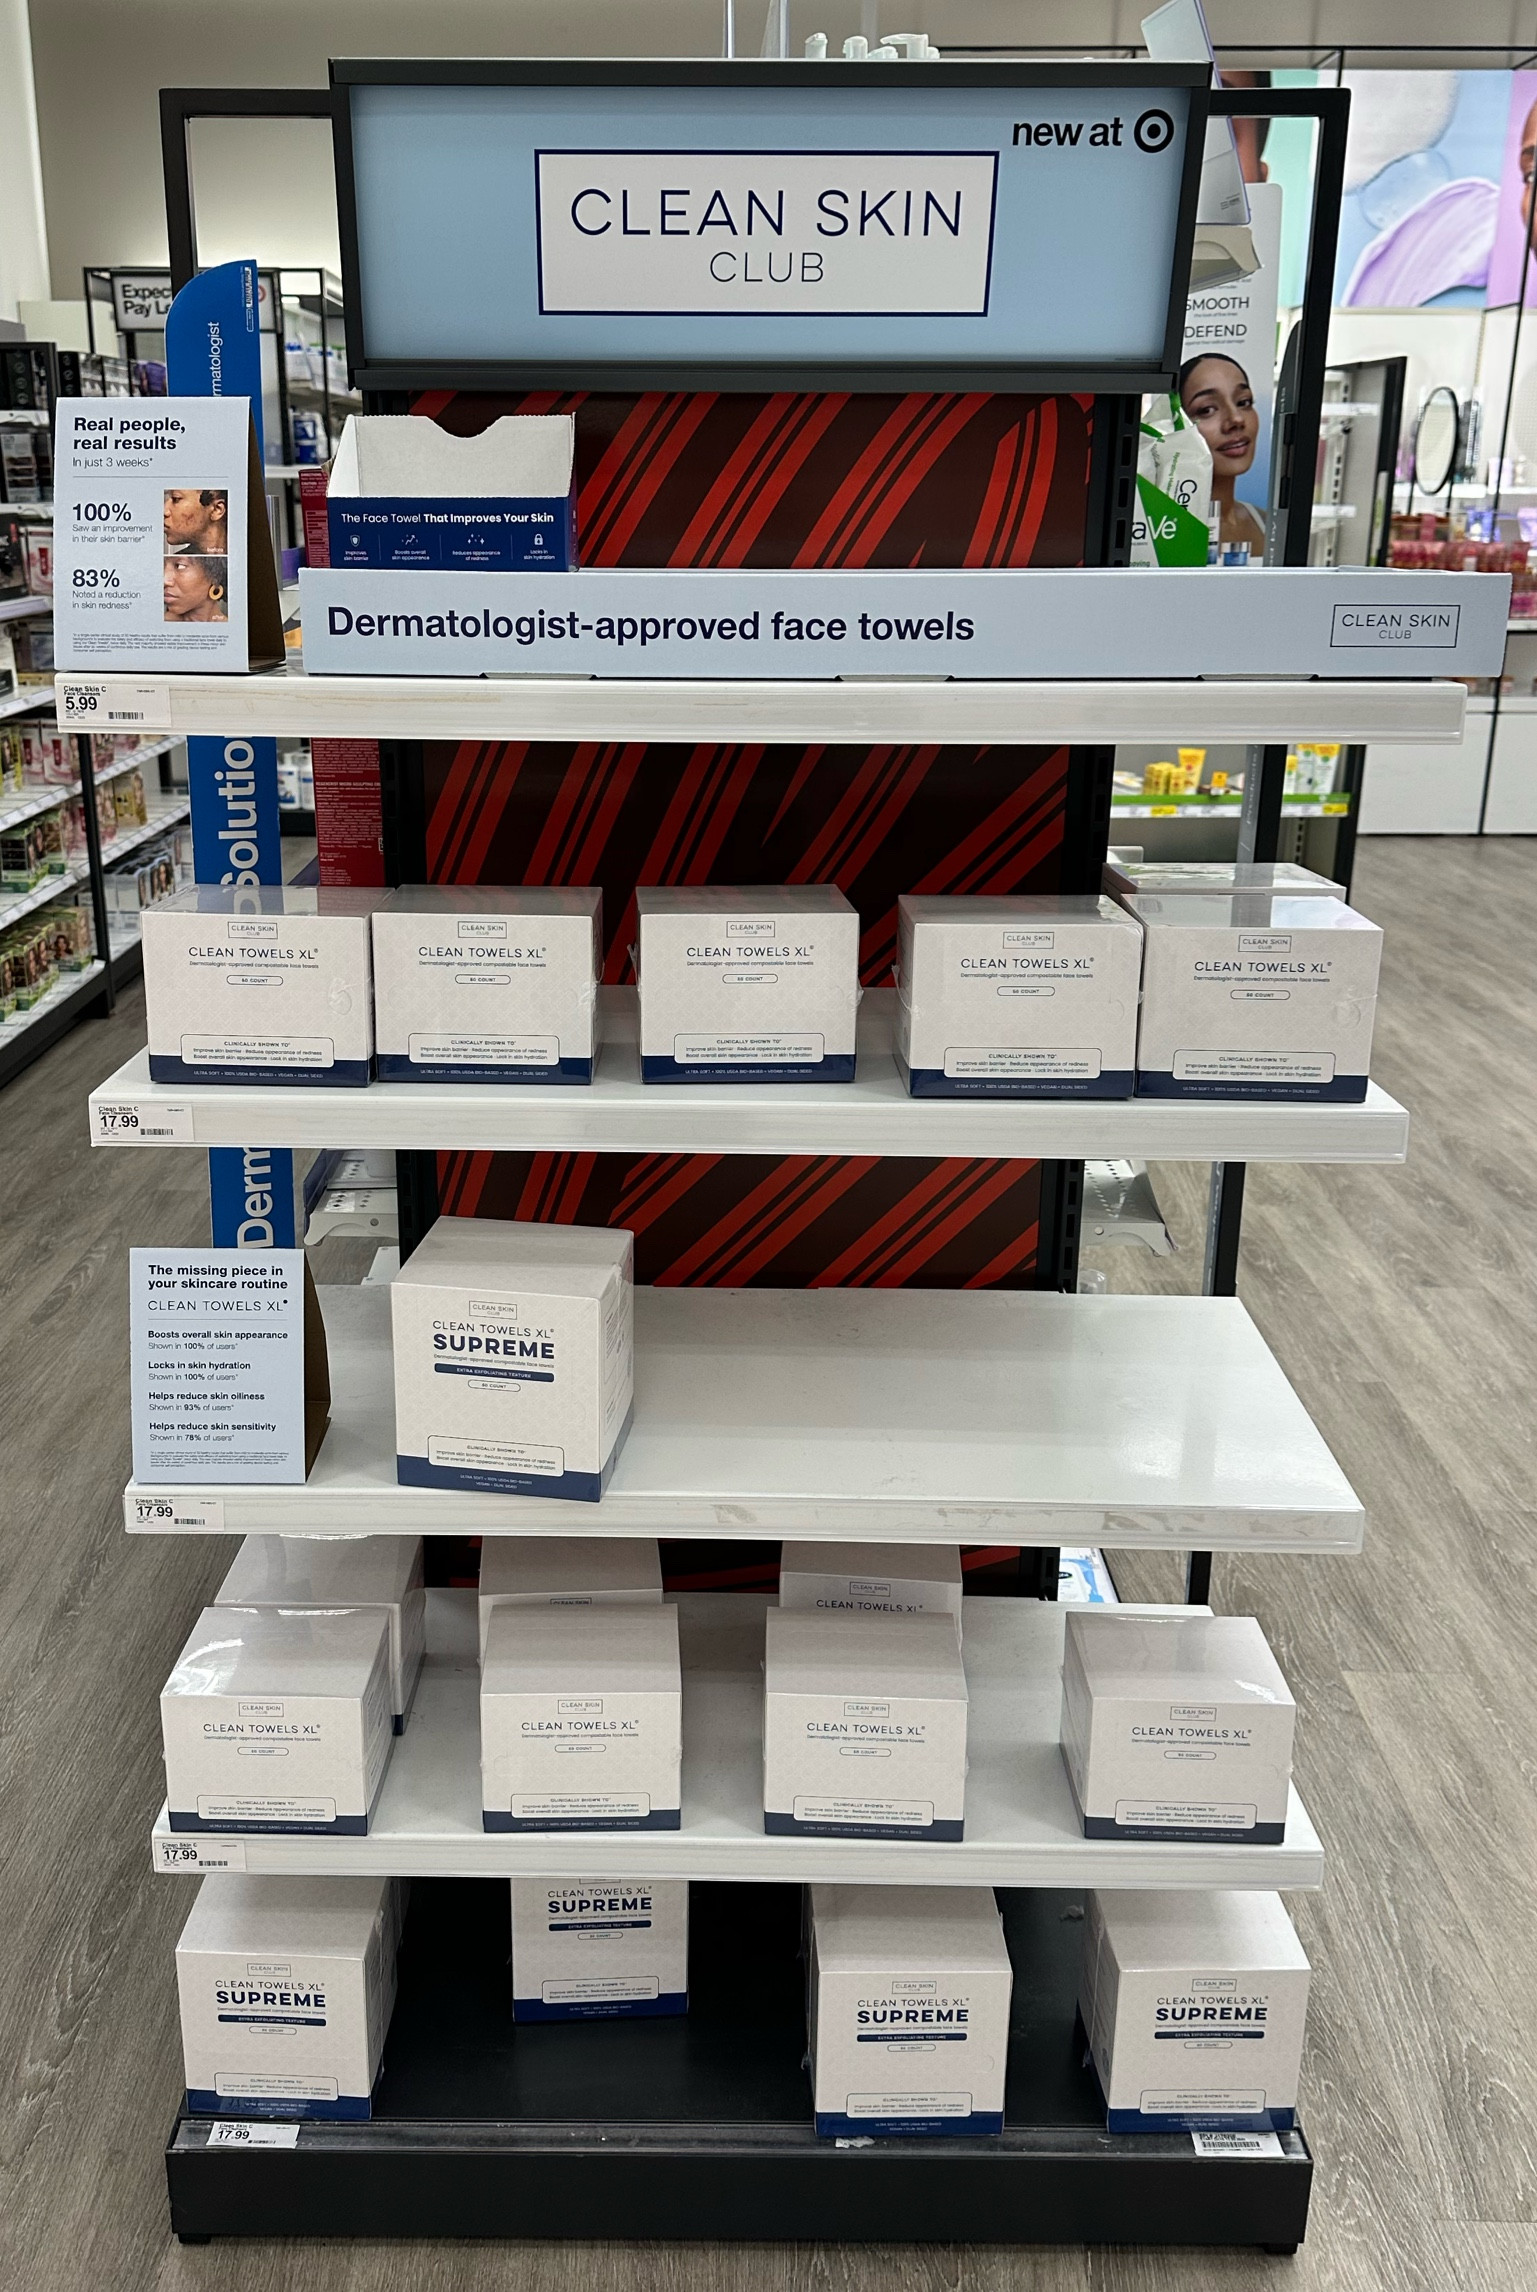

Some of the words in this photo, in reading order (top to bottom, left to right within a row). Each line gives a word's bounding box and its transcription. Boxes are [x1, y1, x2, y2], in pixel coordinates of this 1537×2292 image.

[1011, 123, 1084, 146] new
[1089, 117, 1123, 146] at
[571, 188, 783, 236] CLEAN
[816, 189, 961, 237] SKIN
[710, 251, 823, 282] CLUB
[122, 284, 172, 301] Expec
[123, 300, 151, 318] Pay
[1186, 297, 1249, 311] SMOOTH
[1184, 324, 1247, 339] DEFEND
[207, 322, 224, 397] rmatologist
[74, 417, 113, 431] Real
[120, 417, 185, 434] people,
[73, 435, 107, 450] real
[114, 435, 176, 450] results
[72, 457, 81, 467] In
[84, 457, 103, 469] just
[106, 457, 113, 467] 3
[72, 503, 131, 522] 100%
[341, 513, 360, 523] The
[363, 513, 388, 523] Face
[390, 513, 421, 523] Towel
[423, 513, 448, 523] That
[450, 513, 501, 525] Improves
[503, 513, 529, 523] Your
[530, 512, 554, 522] Skin
[72, 523, 90, 532] Saw
[103, 525, 153, 533] improvement
[81, 535, 98, 543] their
[100, 535, 115, 543] skin
[72, 569, 120, 588] 83%
[72, 590, 96, 598] Noted
[104, 591, 141, 599] reduction
[81, 601, 97, 609] skin
[328, 606, 759, 646] Dermatologist-approved
[770, 611, 847, 640] face
[858, 611, 974, 640] towels
[1342, 613, 1402, 628] CLEAN
[1408, 613, 1451, 628] SKIN
[1378, 629, 1411, 639] CLUB
[65, 696, 97, 710] 5.99
[214, 736, 260, 885] olutio
[188, 946, 234, 957] CLEAN
[239, 948, 294, 959] TOWELS
[418, 946, 463, 957] CLEAN
[468, 947, 522, 958] TOWELS
[686, 947, 731, 957] CLEAN
[736, 946, 790, 957] TOWELS
[960, 958, 1007, 968] CLEAN
[1012, 958, 1068, 968] TOWELS
[1194, 961, 1242, 972] CLEAN
[1247, 962, 1305, 973] TOWELS
[100, 1115, 139, 1128] 17.99
[148, 1264, 173, 1275] The
[177, 1265, 227, 1277] missing
[232, 1265, 267, 1277] piece
[271, 1265, 283, 1276] in
[148, 1280, 177, 1290] your
[181, 1278, 237, 1289] skincare
[241, 1278, 288, 1289] routine
[147, 1300, 196, 1310] CLEAN
[202, 1300, 261, 1311] TOWELS
[472, 1304, 496, 1312] CLEAN
[148, 1330, 180, 1338] Boosts
[181, 1330, 211, 1338] overall
[214, 1330, 232, 1338] skin
[234, 1332, 288, 1340] appearance
[432, 1320, 474, 1334] CLEAN
[479, 1324, 531, 1337] TOWELS
[184, 1342, 205, 1350] 100%
[433, 1333, 554, 1359] SUPREME
[148, 1361, 175, 1369] Locks
[177, 1361, 185, 1369] in
[188, 1361, 206, 1369] skin
[208, 1361, 251, 1370] hydration
[148, 1391, 174, 1401] Helps
[176, 1392, 208, 1400] reduce
[210, 1392, 228, 1400] skin
[230, 1392, 265, 1400] oiliness
[149, 1403, 174, 1411] Shown
[183, 1403, 201, 1411] 93%
[202, 1403, 210, 1411] of
[149, 1422, 175, 1431] Helps
[177, 1422, 208, 1430] reduce
[210, 1422, 229, 1430] skin
[231, 1422, 276, 1432] sensitivity
[149, 1433, 175, 1441] Shown
[136, 1506, 173, 1517] 17.99
[521, 1722, 562, 1730] CLEAN
[567, 1721, 617, 1730] TOWELS
[1132, 1726, 1173, 1736] CLEAN
[1178, 1728, 1229, 1738] TOWELS
[163, 1849, 198, 1860] 17.99
[548, 1897, 652, 1913] SUPREME
[216, 1990, 326, 2007] SUPREME
[857, 2009, 969, 2024] SUPREME
[1156, 2007, 1268, 2021] SUPREME
[217, 2130, 250, 2140] 17.99
